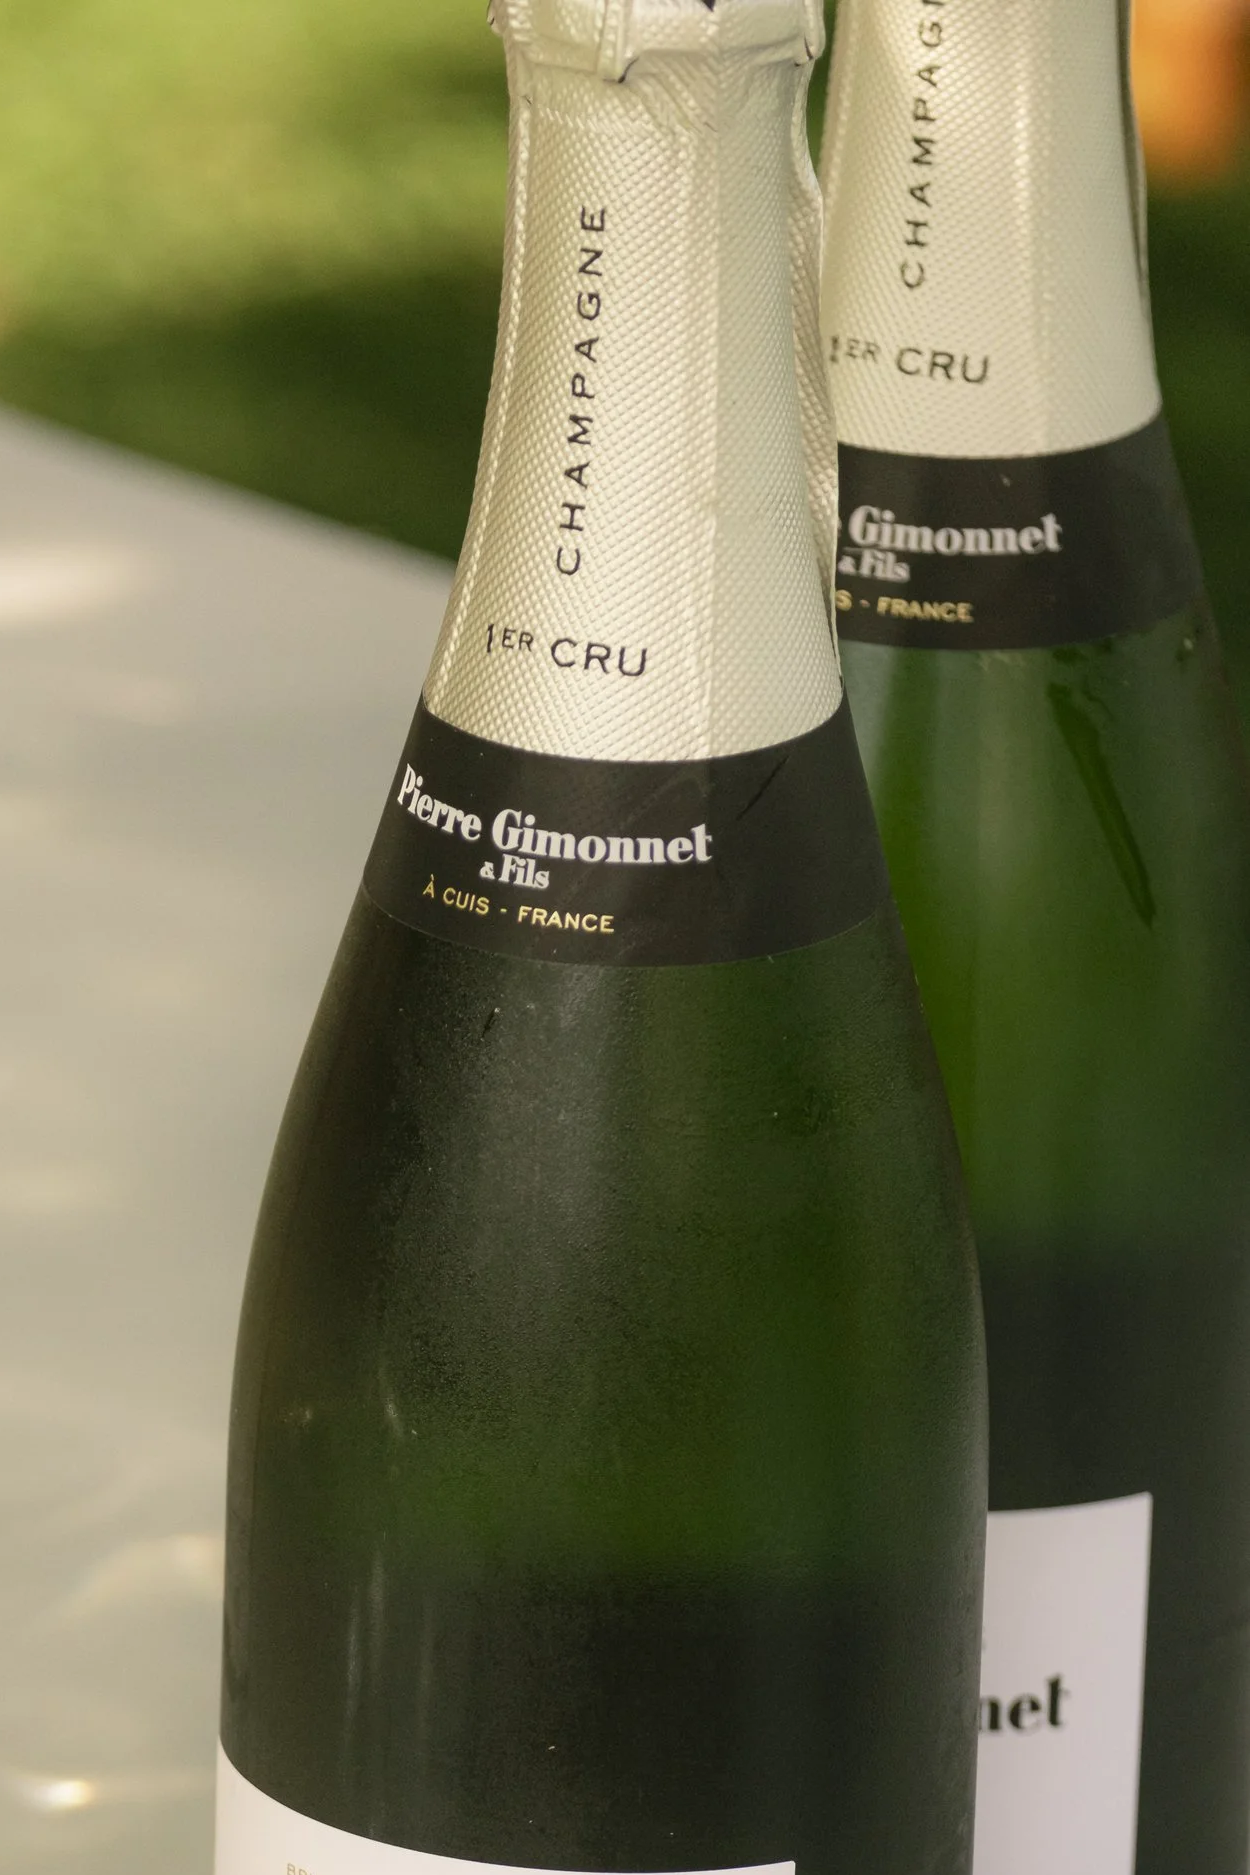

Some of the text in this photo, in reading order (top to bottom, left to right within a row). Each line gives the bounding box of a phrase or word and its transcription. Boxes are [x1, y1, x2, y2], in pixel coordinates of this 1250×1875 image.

[900, 0, 945, 289] CHAMPAG
[556, 205, 606, 576] CHAMPAGNE
[895, 348, 989, 384] CRU
[848, 504, 1063, 557] Gimonnet
[858, 550, 911, 583] Fils
[876, 596, 975, 623] FRANCE
[486, 623, 648, 678] 1ER CRU
[397, 763, 713, 864] Pierre Gimonnet
[479, 853, 550, 889] & Fils
[422, 874, 435, 898] À
[443, 887, 490, 915] CUIS
[518, 905, 615, 934] FRANCE
